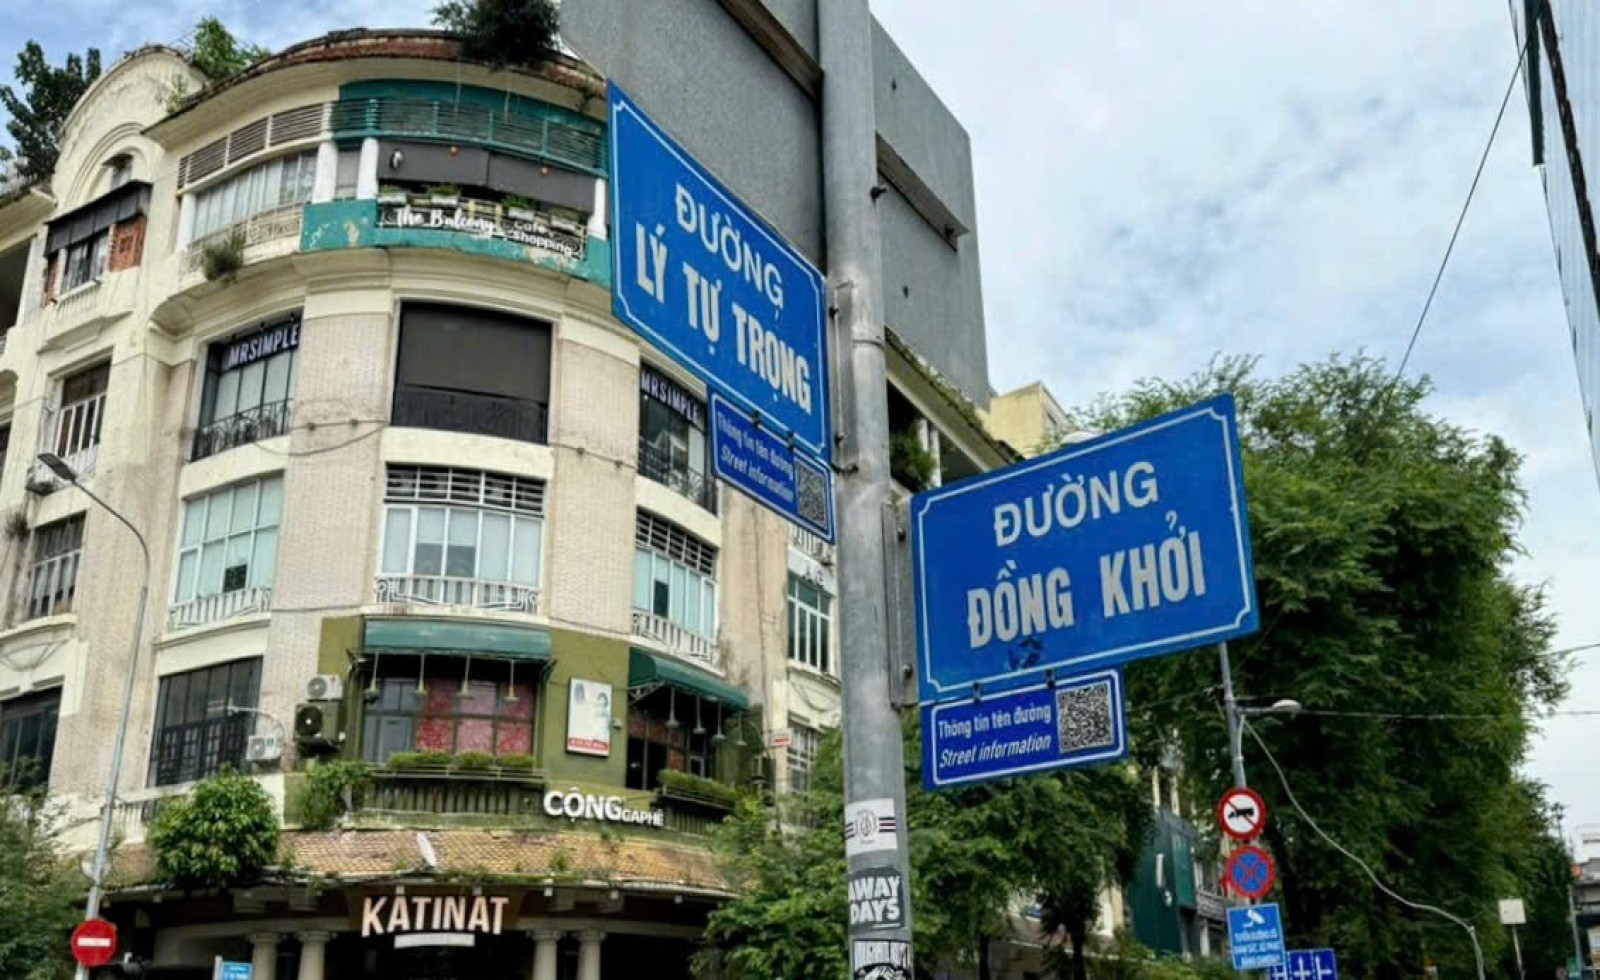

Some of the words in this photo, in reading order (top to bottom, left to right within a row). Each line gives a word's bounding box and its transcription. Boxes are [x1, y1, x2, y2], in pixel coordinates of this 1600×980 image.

[396, 204, 425, 228] The
[675, 184, 784, 319] ĐƯỜNG
[635, 222, 668, 304] LÝ
[682, 261, 723, 356] TỰ
[732, 302, 812, 415] TRỌNG
[228, 323, 299, 367] MRSIMPLE
[641, 371, 699, 424] MRSIMPLE
[994, 461, 1159, 547] ĐƯỜNG
[967, 559, 1074, 649] ĐỒNG
[1099, 510, 1206, 619] KHỞI
[938, 719, 972, 740] Thông
[974, 711, 990, 732] tin
[992, 707, 1012, 730] tên
[1014, 702, 1051, 725] đường
[939, 744, 977, 770] Street
[978, 733, 1052, 761] information
[543, 786, 623, 822] CỘNG
[848, 876, 900, 902] AWAY
[361, 895, 509, 938] KATINAT
[850, 898, 900, 925] DAYS
